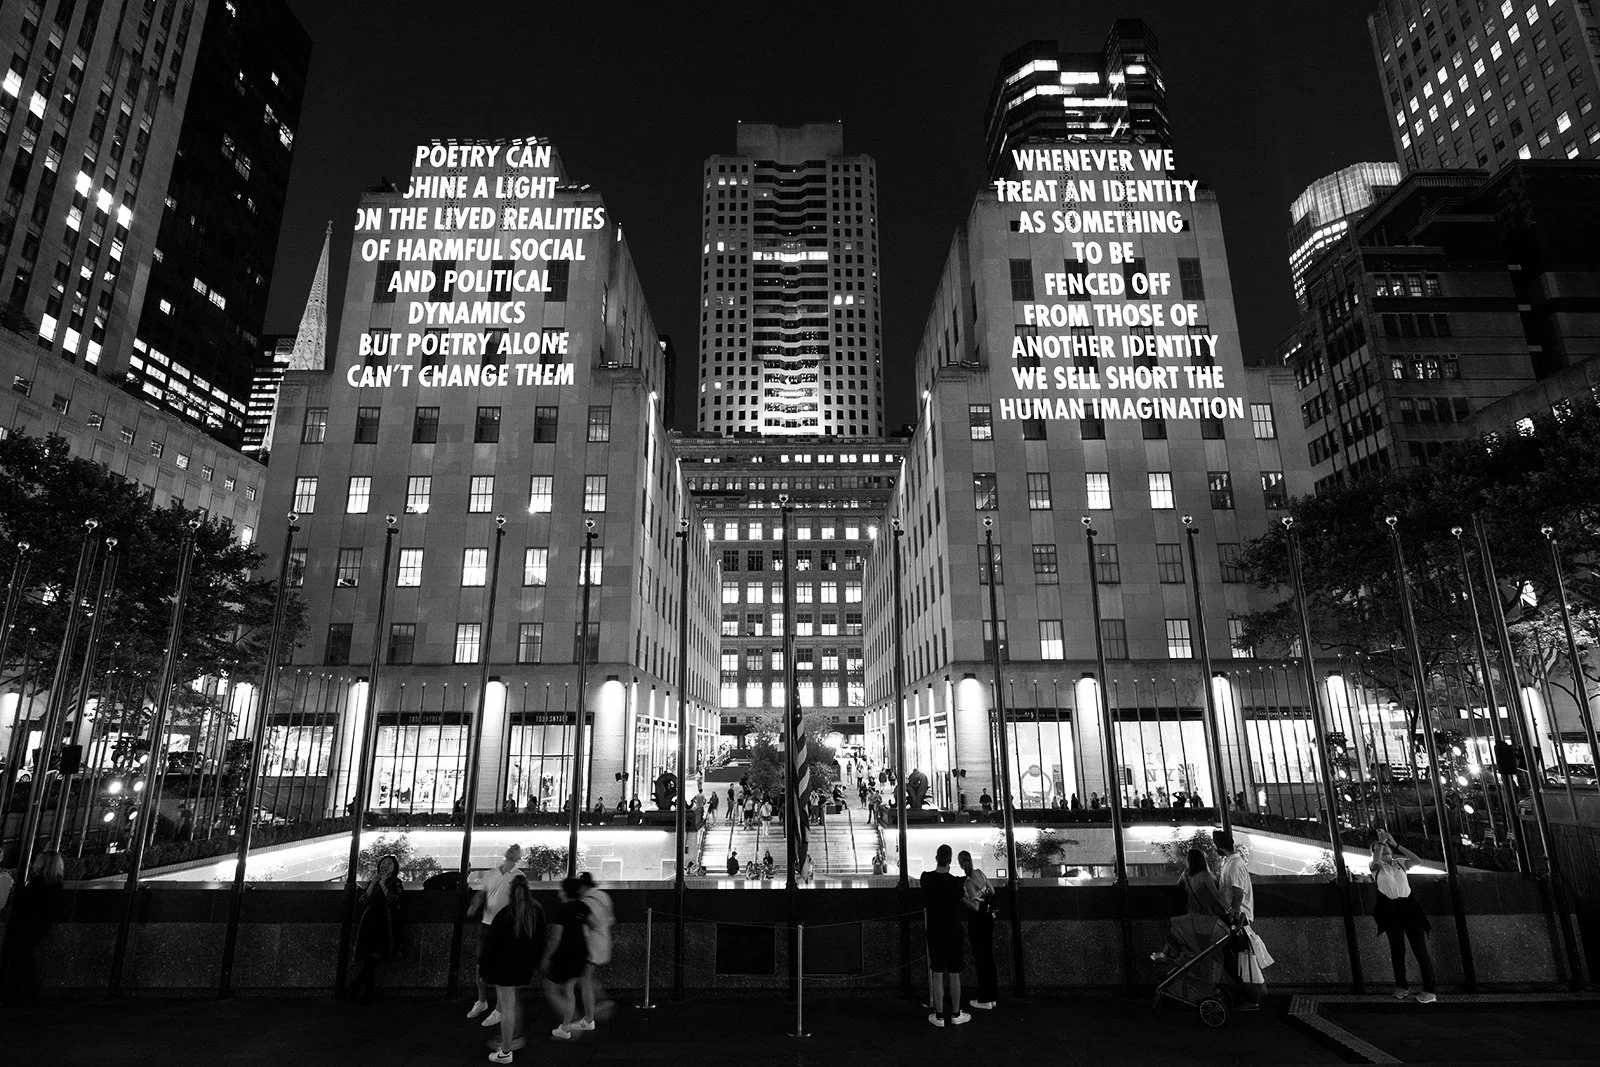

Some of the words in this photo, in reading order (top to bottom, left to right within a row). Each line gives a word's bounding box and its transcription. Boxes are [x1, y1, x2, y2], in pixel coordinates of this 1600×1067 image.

[414, 145, 500, 168] POETRY
[505, 144, 552, 168] CAN
[1011, 149, 1135, 172] WHENEVER
[1139, 149, 1175, 171] WE
[402, 176, 468, 199] SHINE
[472, 176, 489, 199] A
[495, 176, 559, 199] LIGHT
[993, 178, 1058, 202] TREAT
[1064, 179, 1096, 202] AN
[1102, 179, 1199, 202] IDENTITY
[389, 207, 428, 231] THE
[433, 207, 496, 230] LIVED
[502, 206, 605, 230] REALITIES
[1018, 210, 1046, 234] AS
[1053, 210, 1184, 234] SOMETHING
[361, 238, 391, 262] OF
[396, 238, 503, 262] HARMFUL
[509, 238, 586, 262] SOCIAL
[1072, 241, 1103, 264] TO
[1108, 241, 1135, 264] BE
[387, 270, 436, 293] AND
[443, 269, 552, 293] POLITICAL
[1044, 272, 1125, 296] FENCED
[1131, 272, 1171, 295] OFF
[408, 301, 526, 324] DYNAMICS
[1023, 304, 1089, 327] FROM
[1093, 304, 1165, 327] THOSE
[1170, 303, 1199, 327] OF
[358, 332, 402, 356] BUT
[406, 332, 493, 356] POETRY
[496, 331, 570, 355] ALONE
[1011, 335, 1116, 359] ANOTHER
[1121, 334, 1218, 358] IDENTITY
[347, 364, 413, 388] CAN'T
[418, 363, 508, 388] CHANGE
[515, 363, 575, 386] THEM
[1011, 366, 1048, 390] WE
[1053, 366, 1101, 390] SELL
[1105, 365, 1179, 390] SHORT
[1183, 365, 1225, 389] THE
[999, 397, 1085, 420] HUMAN
[1092, 397, 1245, 420] IMAGINATION
